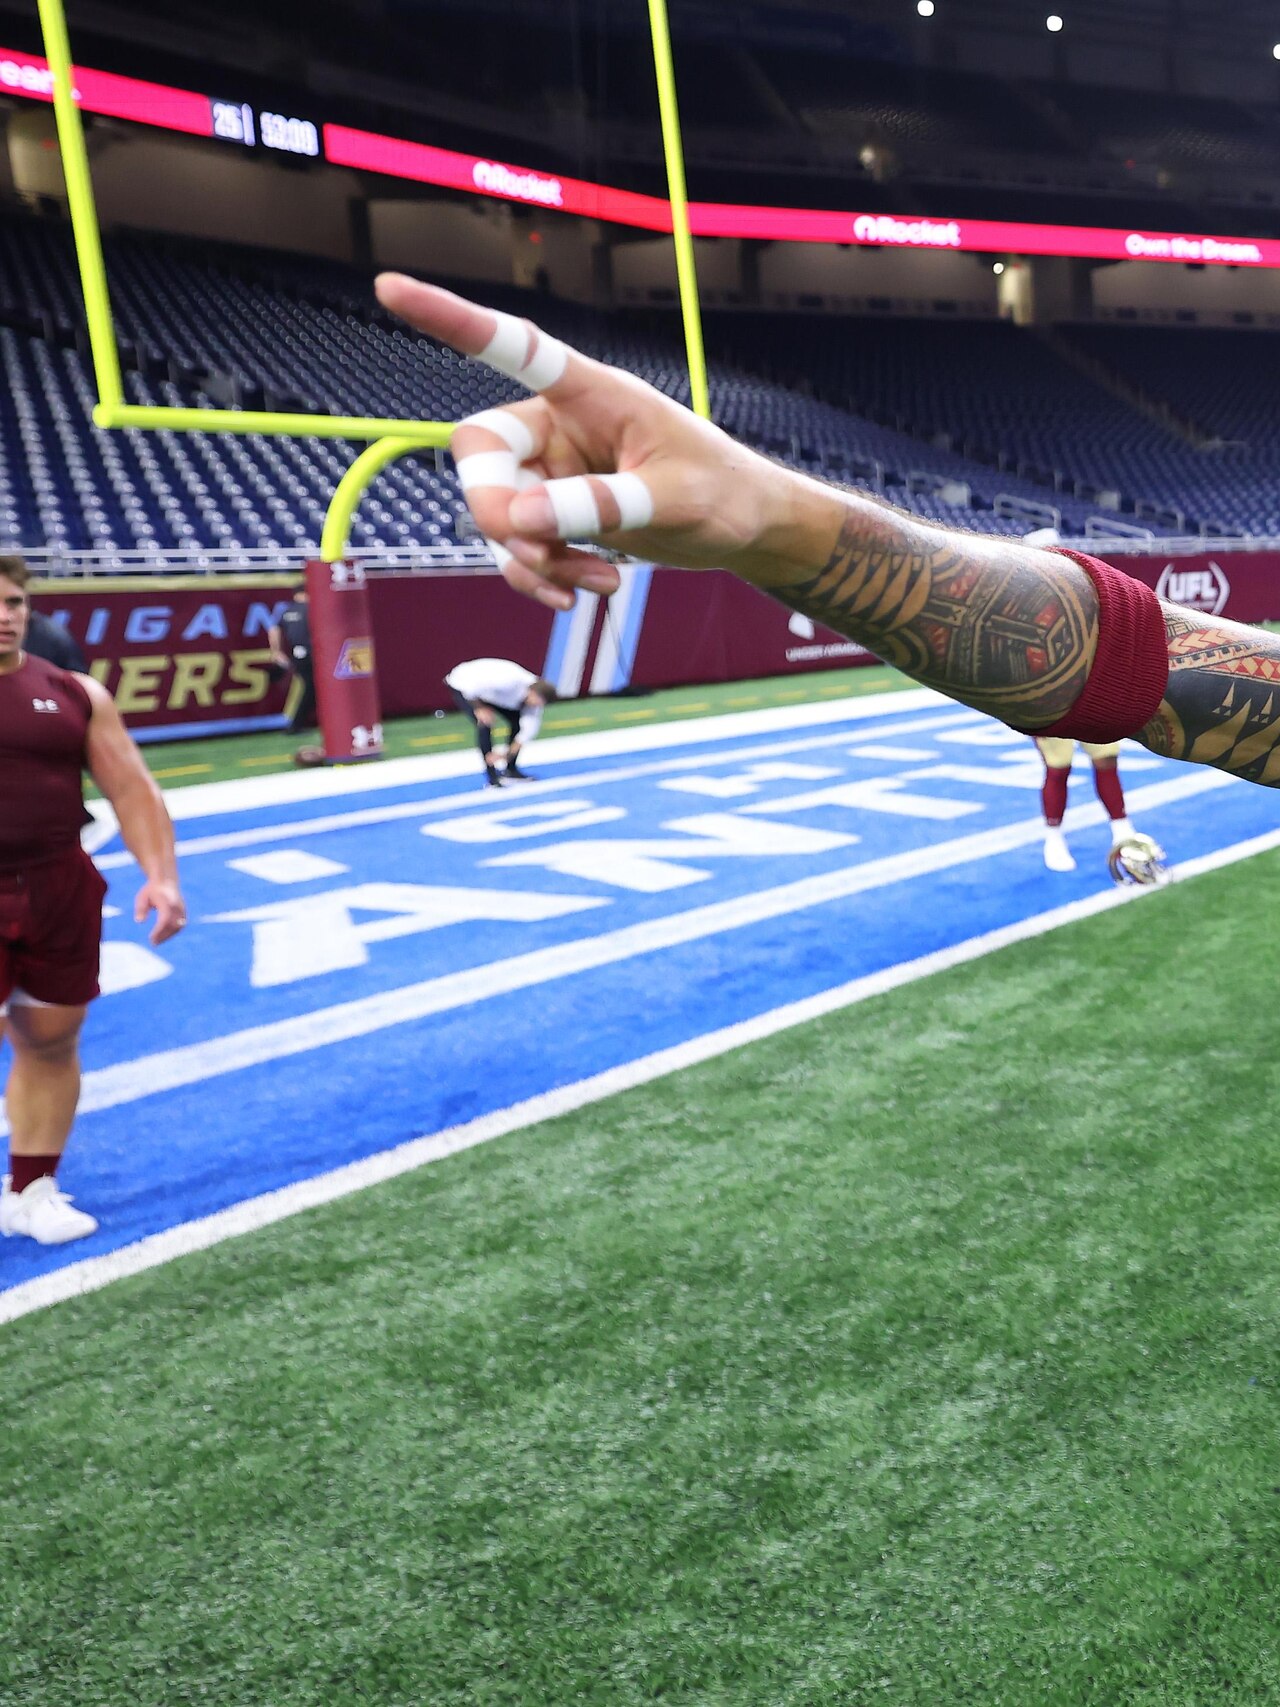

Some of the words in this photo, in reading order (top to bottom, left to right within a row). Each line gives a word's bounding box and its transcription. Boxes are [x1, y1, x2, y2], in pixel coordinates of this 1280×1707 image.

[489, 163, 564, 207] Rocket
[876, 216, 961, 247] Rocket
[1125, 234, 1171, 256] Own
[1171, 237, 1201, 259] the
[1168, 570, 1218, 602] UFL
[52, 601, 289, 646] IGAN
